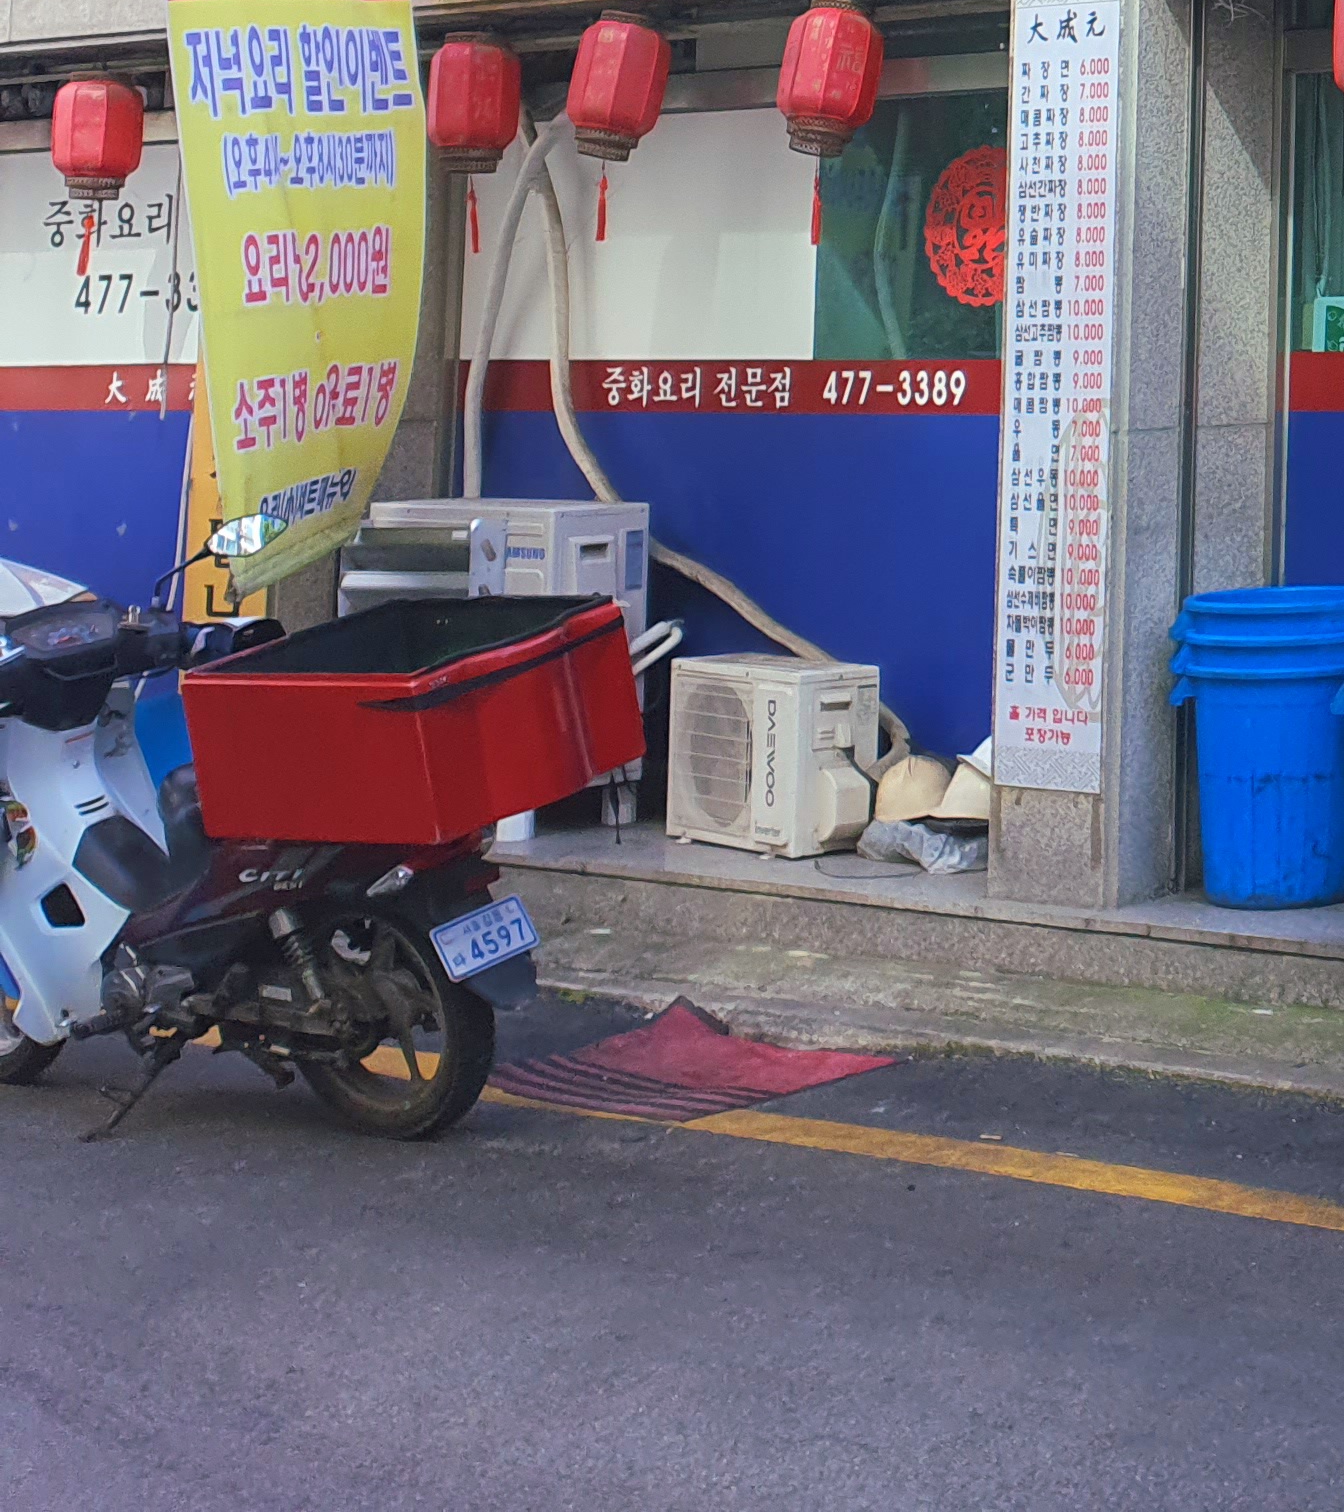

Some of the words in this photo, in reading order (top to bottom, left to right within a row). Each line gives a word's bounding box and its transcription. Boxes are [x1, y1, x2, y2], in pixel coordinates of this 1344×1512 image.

[185, 25, 294, 118] 저녁요리
[299, 24, 413, 113] 할인이벤트
[1080, 58, 1109, 76] 6.000
[1080, 82, 1109, 100] 7.000
[1079, 106, 1109, 123] 8.000
[1078, 130, 1108, 148] 8.000
[1077, 153, 1107, 171] 8.000
[1077, 177, 1107, 195] 8.000
[1076, 202, 1106, 220] 8.000
[44, 193, 173, 248] 중화요리
[1075, 226, 1105, 244] 8.000
[1074, 250, 1105, 268] 8.000
[1074, 274, 1105, 292] 7.000
[1067, 299, 1104, 316] 10.000
[1067, 323, 1104, 341] 10.000
[1072, 349, 1103, 365] 9.000
[602, 366, 702, 408] 중화요리
[713, 366, 792, 409] 전문점
[822, 369, 967, 407] 477-3389
[1072, 372, 1103, 389] 9.000
[234, 371, 308, 451] 소주1병
[1066, 397, 1102, 414] 10.000
[1071, 420, 1101, 438] 7.000
[1070, 445, 1100, 462] 7.000
[1064, 469, 1099, 487] 10.000
[1063, 494, 1099, 512] 10.000
[1068, 519, 1098, 537] 9.000
[505, 547, 546, 560] AMSUNG
[1067, 543, 1098, 561] 9.000
[1061, 568, 1100, 586] 10.000
[1060, 593, 1096, 611] 10.000
[1060, 618, 1095, 636] 10.000
[1065, 642, 1095, 661] 6.000
[1064, 668, 1094, 686] 6.000
[1025, 707, 1047, 722] 가격
[1052, 708, 1089, 725] 입니다
[765, 699, 777, 808] DAEWOO
[470, 917, 525, 960] 4597
